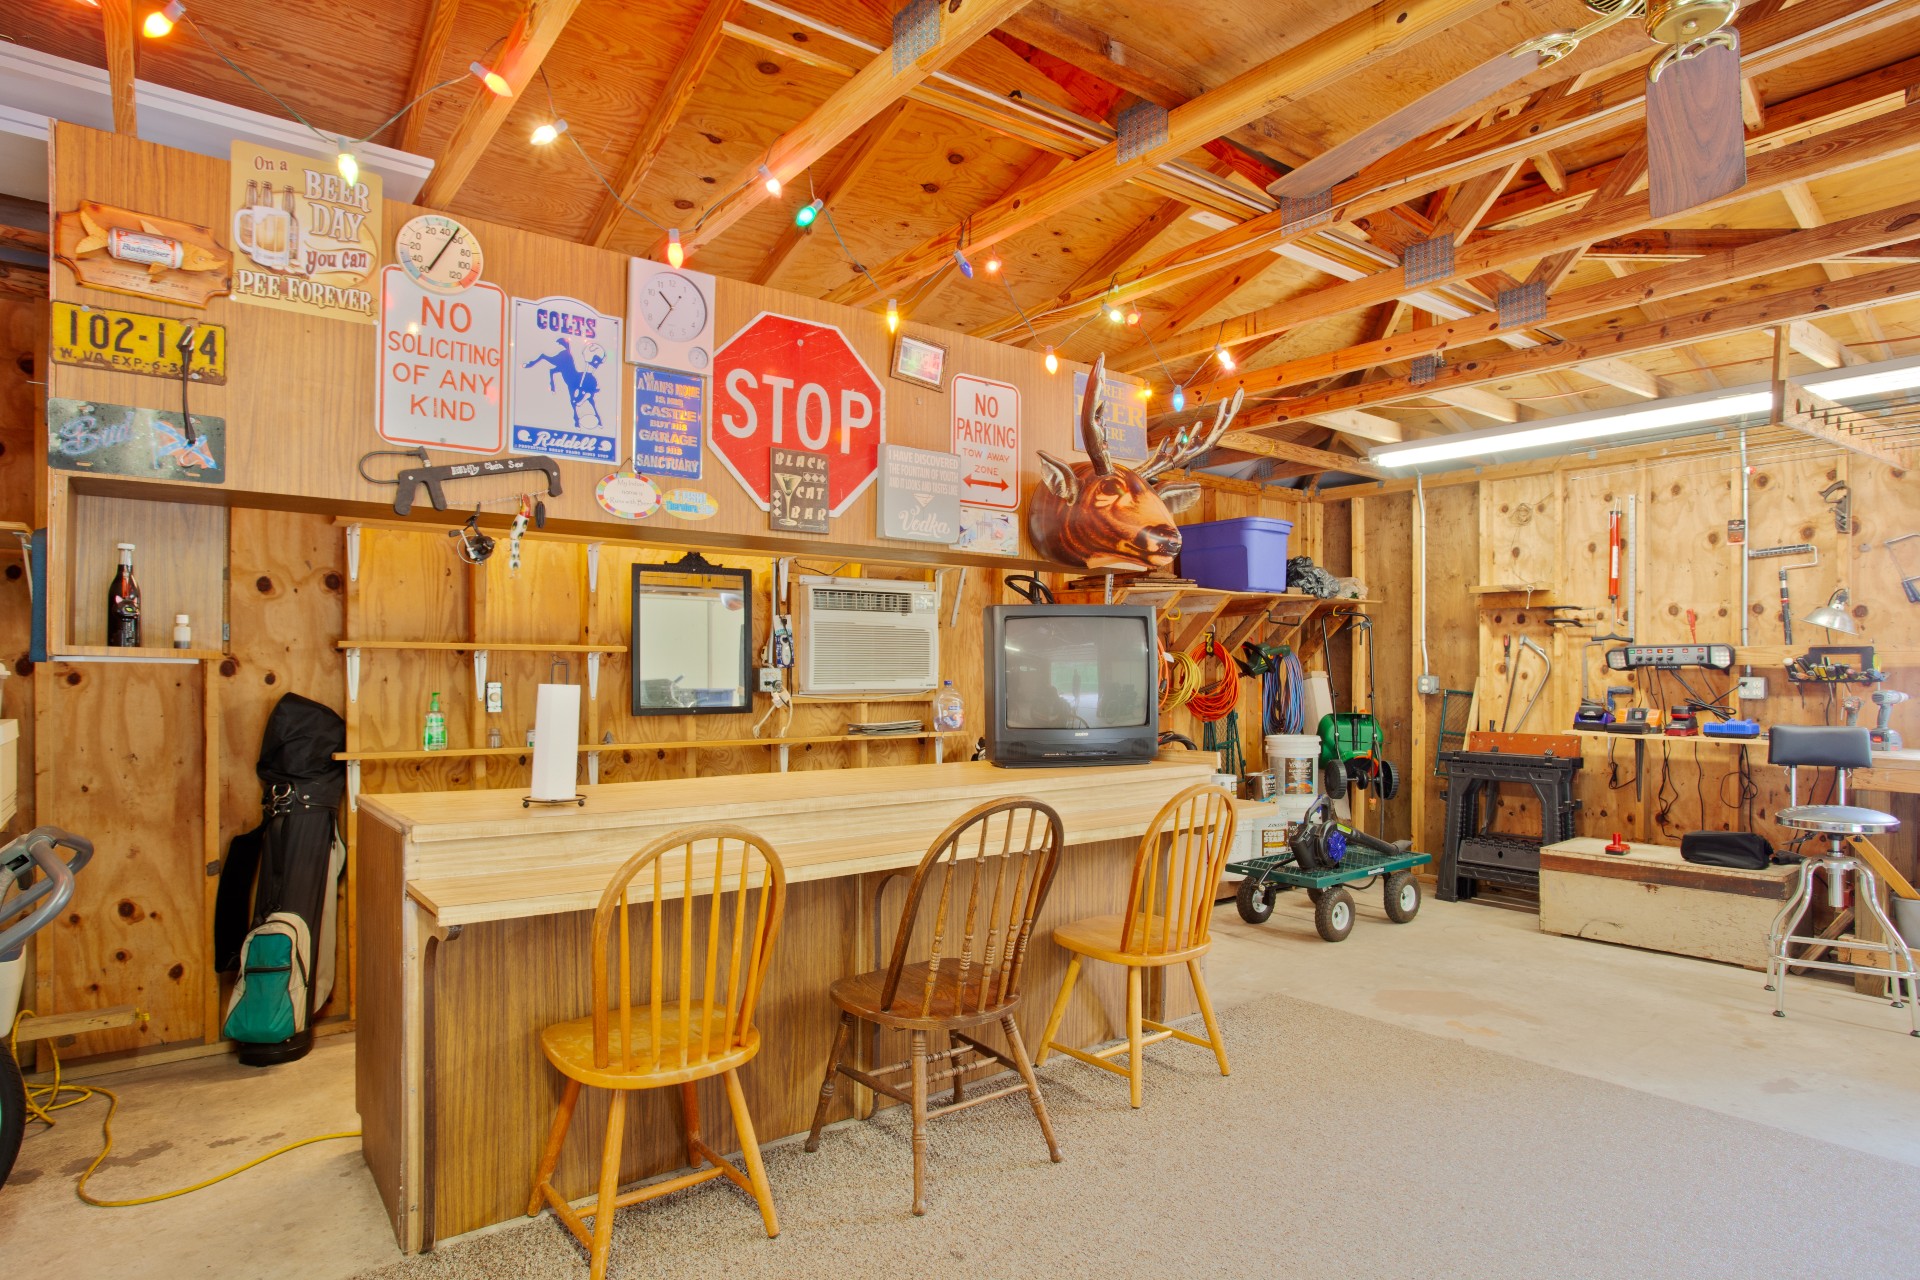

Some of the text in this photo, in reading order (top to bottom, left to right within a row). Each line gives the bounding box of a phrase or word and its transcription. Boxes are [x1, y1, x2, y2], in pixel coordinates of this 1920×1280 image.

[254, 156, 288, 171] On a
[304, 169, 371, 212] BEER
[308, 202, 366, 242] DAY
[425, 226, 436, 236] 20
[416, 232, 422, 240] 0
[440, 228, 451, 236] 40
[452, 236, 464, 244] 60
[122, 242, 170, 258] Budweiser
[460, 248, 471, 258] 80
[306, 250, 367, 274] you can
[458, 262, 470, 270] 100
[449, 270, 462, 280] 120
[658, 280, 664, 288] 11
[237, 270, 373, 316] PEE FOREVER
[648, 288, 656, 296] 10
[422, 296, 472, 333] NO
[536, 308, 596, 339] COLTS
[60, 347, 77, 359] W.
[388, 331, 500, 366] SOLICITING
[392, 362, 494, 396] OF ANY
[638, 378, 700, 398] A MAN'S HOME
[656, 395, 666, 404] IS
[1103, 384, 1124, 400] REE
[410, 394, 475, 422] KIND
[640, 404, 696, 422] CASTLE
[722, 368, 872, 454] STOP
[974, 392, 998, 418] NO
[60, 411, 135, 456] Bud
[650, 420, 688, 432] BUT HIS
[957, 418, 1016, 448] PARKING
[1108, 427, 1126, 442] ERE
[533, 431, 597, 451] Riddell
[639, 429, 698, 448] GARAGE
[654, 445, 682, 456] IS HIS
[962, 448, 1010, 463] TOW AWAY
[636, 454, 699, 472] SANCTUARY
[775, 452, 826, 470] BLACK
[889, 450, 958, 470] I HAVE DISCOVERED
[889, 462, 958, 483] THE FOUNTAIN OF YOUTH
[974, 464, 998, 476] ZONE
[796, 486, 824, 500] CAT
[889, 477, 900, 488] AND
[922, 480, 932, 492] AND
[932, 482, 948, 494] TASTES
[949, 484, 958, 496] LIKE
[790, 506, 826, 520] BAR
[899, 505, 950, 538] Vodka
